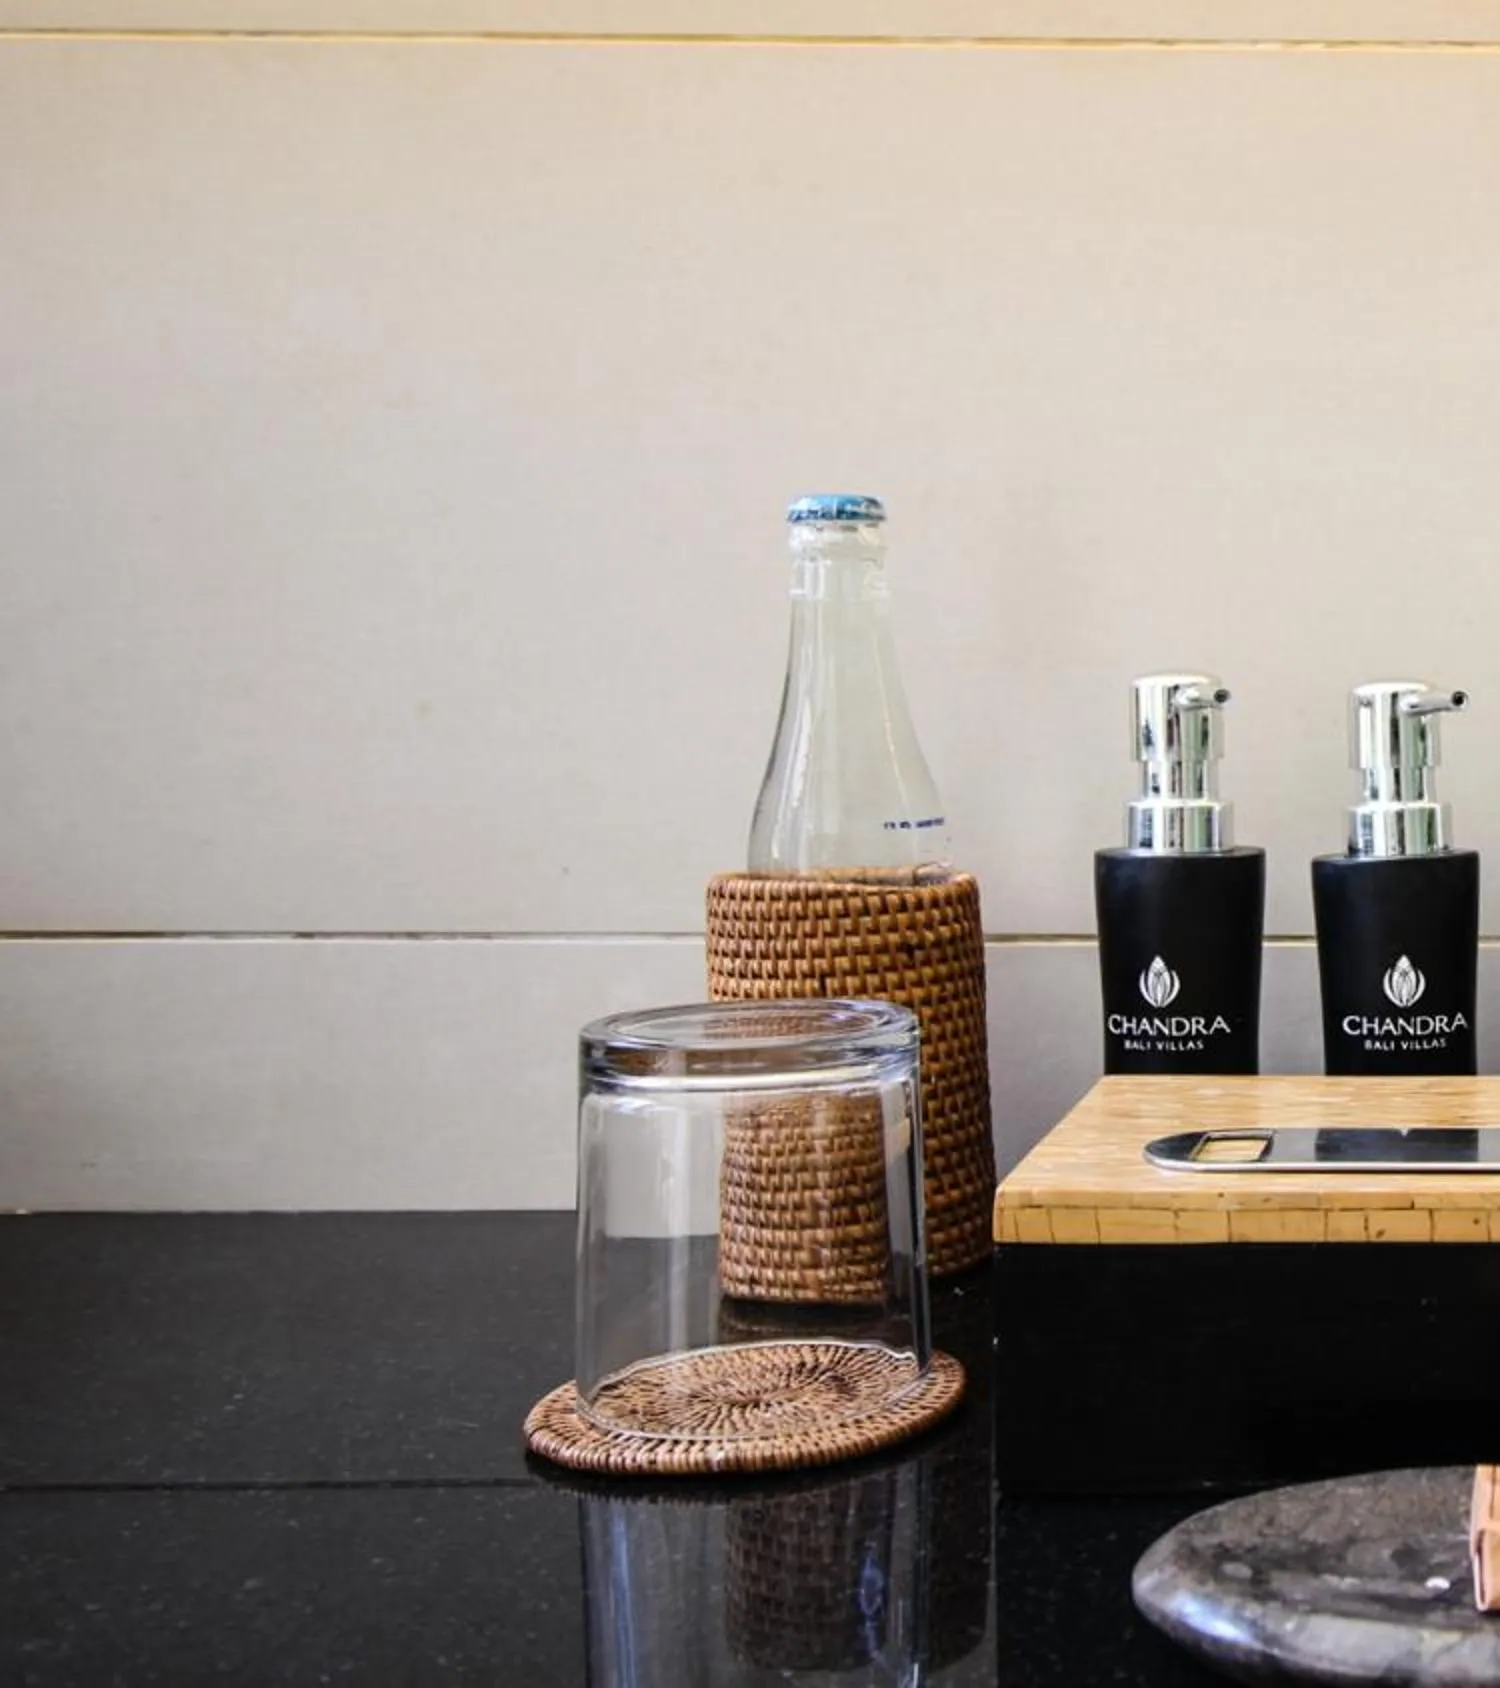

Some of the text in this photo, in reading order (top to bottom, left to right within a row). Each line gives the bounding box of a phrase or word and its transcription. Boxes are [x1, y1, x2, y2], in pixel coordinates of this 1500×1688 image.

[1107, 1013, 1231, 1036] CHANDRA
[1342, 1012, 1468, 1036] CHANDRA
[1124, 1040, 1204, 1051] BALI VILLAS
[1364, 1038, 1446, 1050] BALI VILLAS
